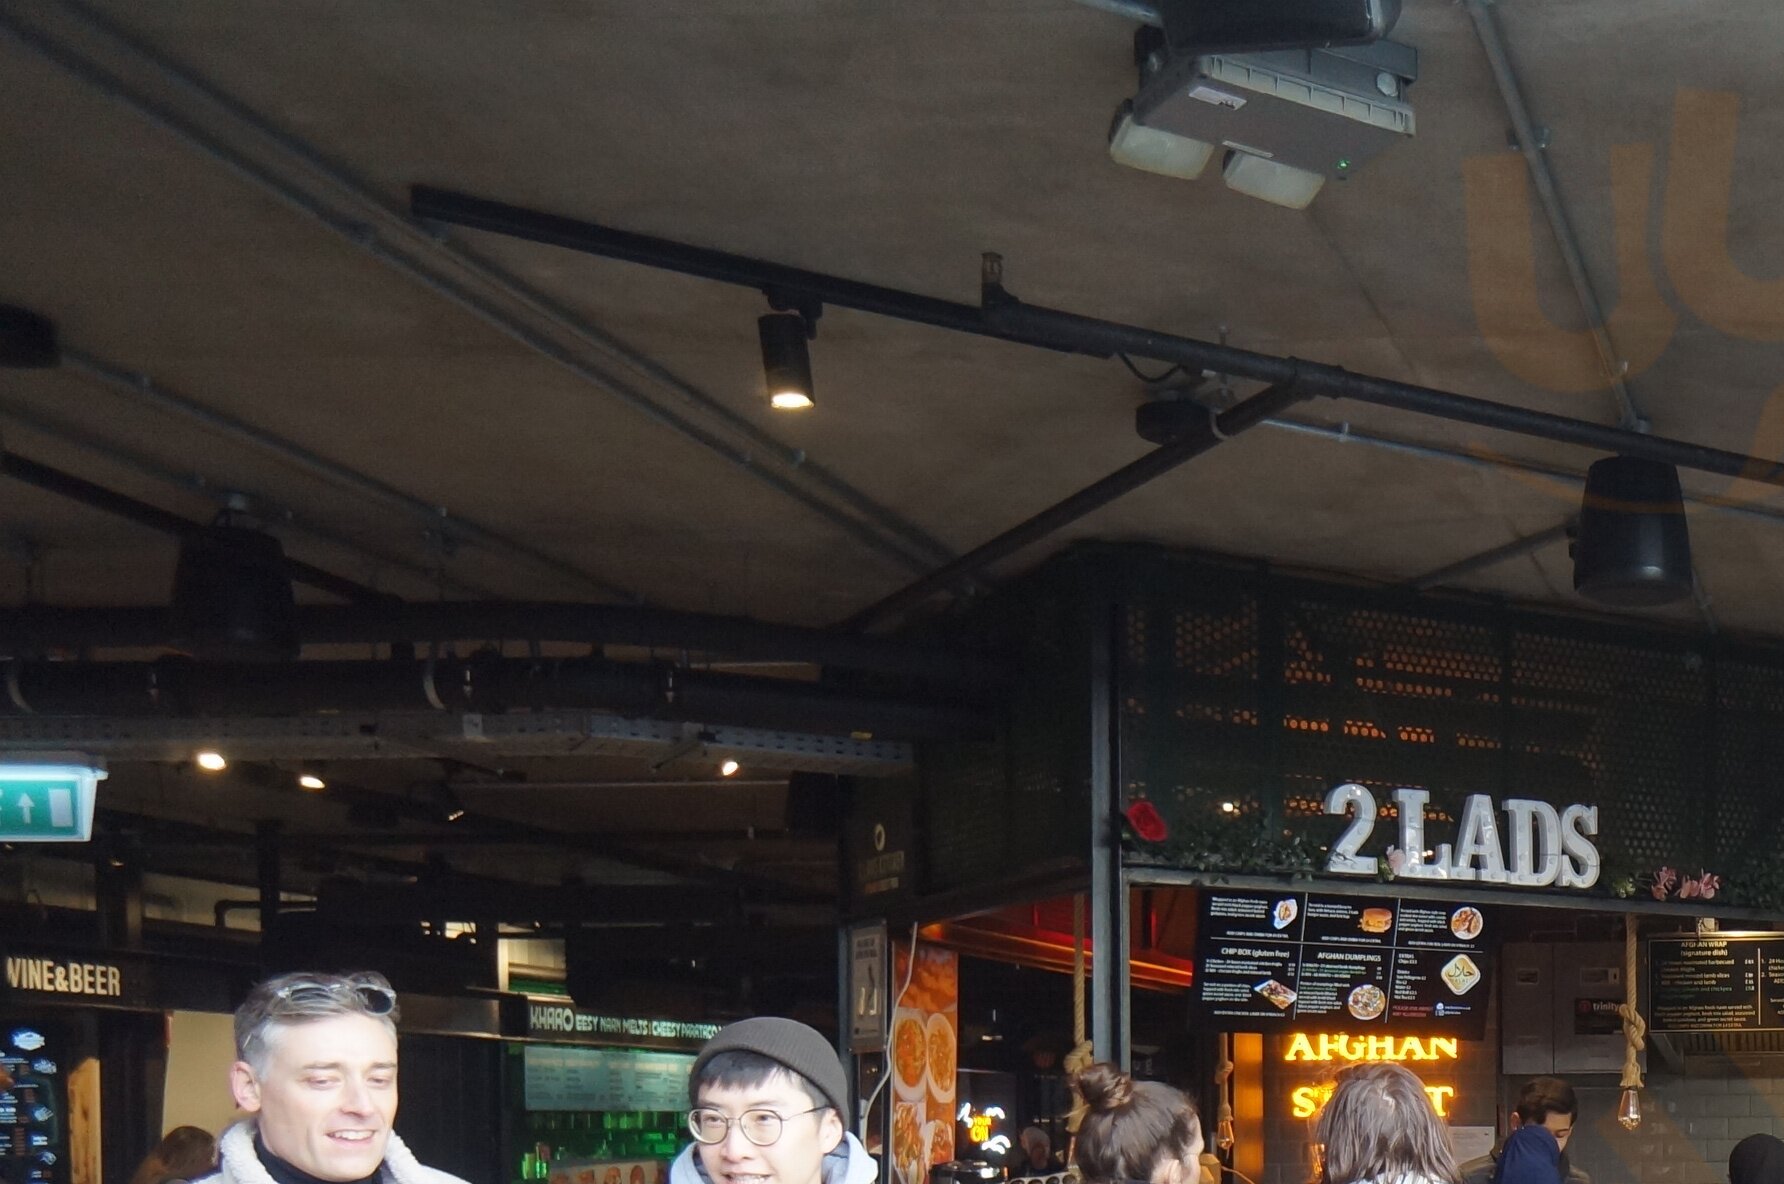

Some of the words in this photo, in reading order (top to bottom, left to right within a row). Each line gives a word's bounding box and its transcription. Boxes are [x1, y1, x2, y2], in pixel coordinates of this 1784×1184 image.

[1324, 783, 1378, 875] 2
[1392, 788, 1601, 888] LADS
[1318, 952, 1344, 960] AFGHAN
[1345, 954, 1381, 962] DUMPLINGS
[622, 1018, 648, 1035] MELTS
[652, 1020, 680, 1038] CHEESY
[1285, 1032, 1458, 1062] AFGHAN
